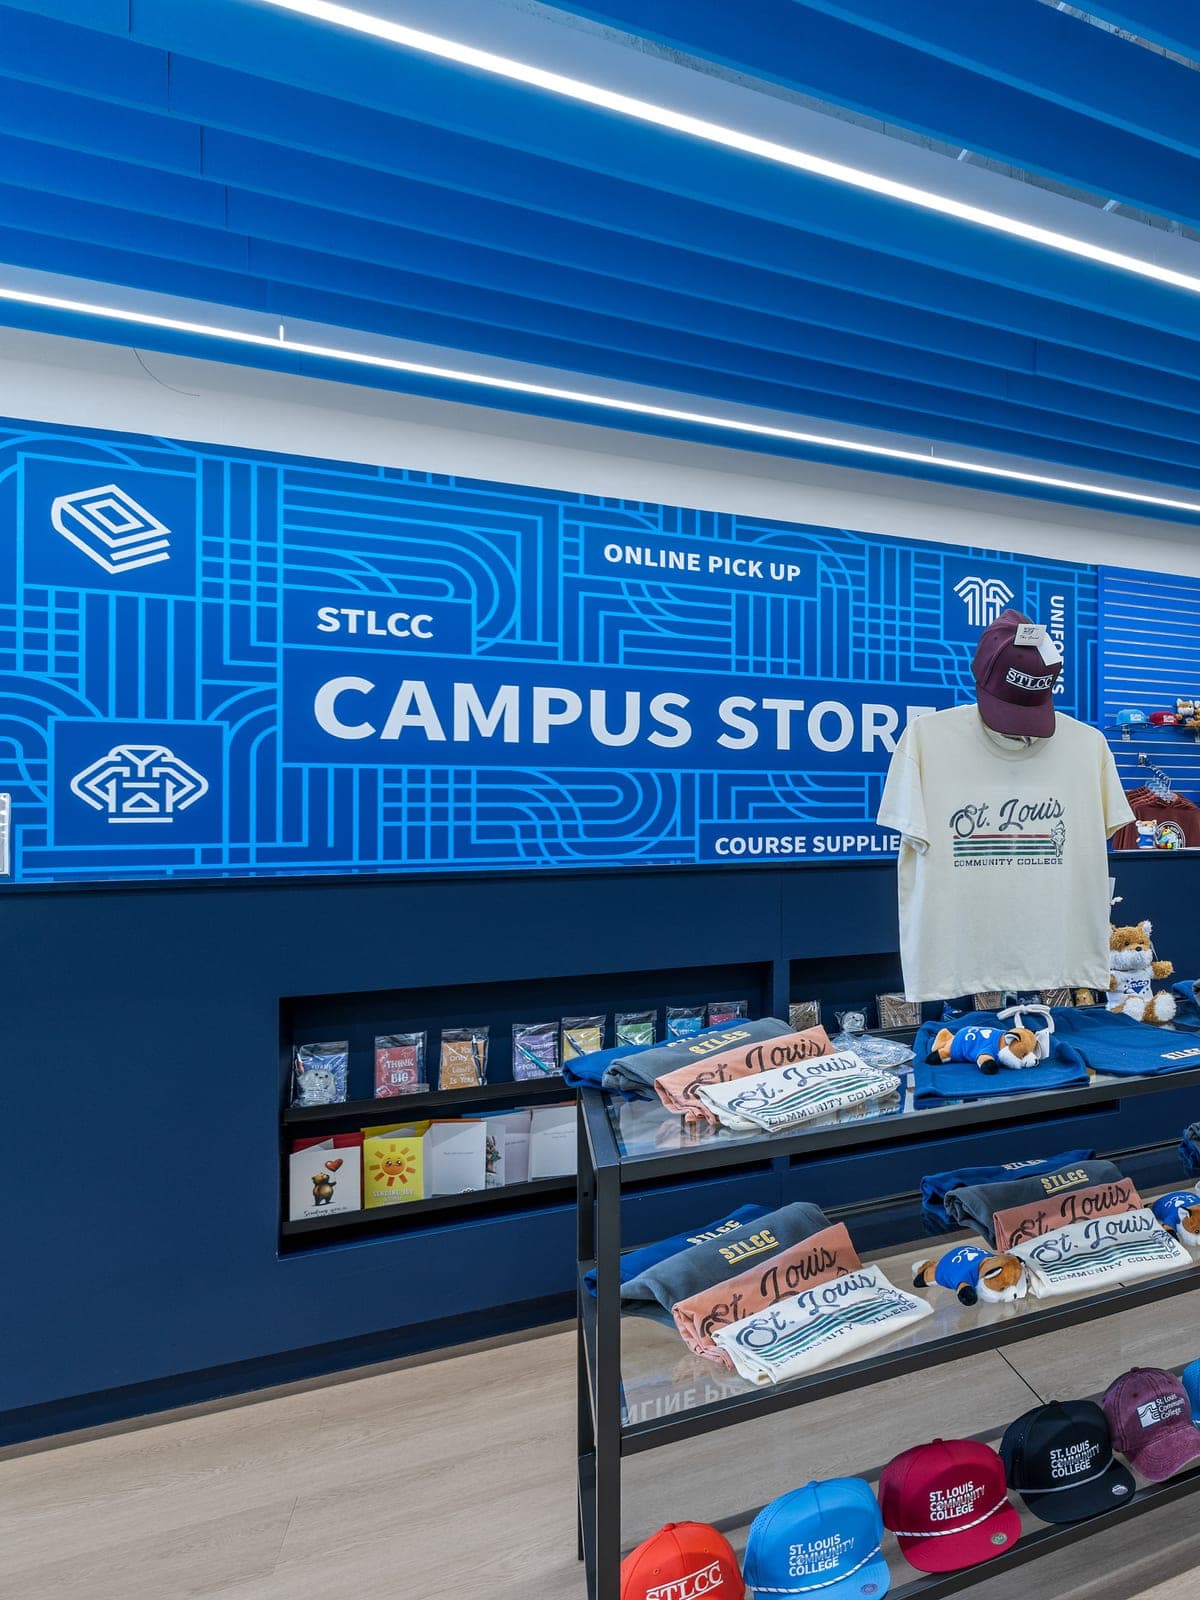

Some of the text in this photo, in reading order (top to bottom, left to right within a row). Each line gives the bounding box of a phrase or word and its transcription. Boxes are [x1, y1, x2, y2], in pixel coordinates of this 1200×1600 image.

[603, 544, 801, 582] ONLINE PICK UP
[316, 606, 434, 639] STLCC
[1050, 595, 1065, 695] UNIFOMS
[1006, 669, 1053, 690] STLCC
[314, 676, 937, 753] CAMPUS STOR
[949, 797, 1066, 838] St. Louis
[715, 834, 902, 855] COURSE SUPPLIE
[954, 859, 1013, 867] COMMUNITY
[688, 1030, 752, 1055] STLCC
[745, 1038, 827, 1073] Louis
[390, 1072, 409, 1084] BIG
[728, 1056, 857, 1112] St. Louis
[767, 1078, 901, 1126] COMMUNITY COLLEGE
[1040, 1168, 1088, 1189] STLCC
[1060, 1183, 1131, 1224] Louis
[718, 1228, 777, 1261] STLCC
[1029, 1215, 1157, 1264] St. Louis
[760, 1246, 838, 1307] Louis
[1049, 1261, 1123, 1283] COMMUNITY
[735, 1274, 877, 1349] St. Louis
[1050, 1440, 1090, 1460] ST. LOUIS
[1050, 1443, 1100, 1469] COMMUNITY
[1051, 1460, 1092, 1478] COLLEGE
[929, 1480, 974, 1502] ST. LOUIS
[929, 1484, 985, 1512] COMMUNITY
[929, 1502, 974, 1522] COLLEGE
[788, 1537, 856, 1567] COMMUNITY
[789, 1533, 841, 1556] ST. LOUIS
[788, 1556, 840, 1577] COLLEGE
[645, 1563, 724, 1600] STLCC
